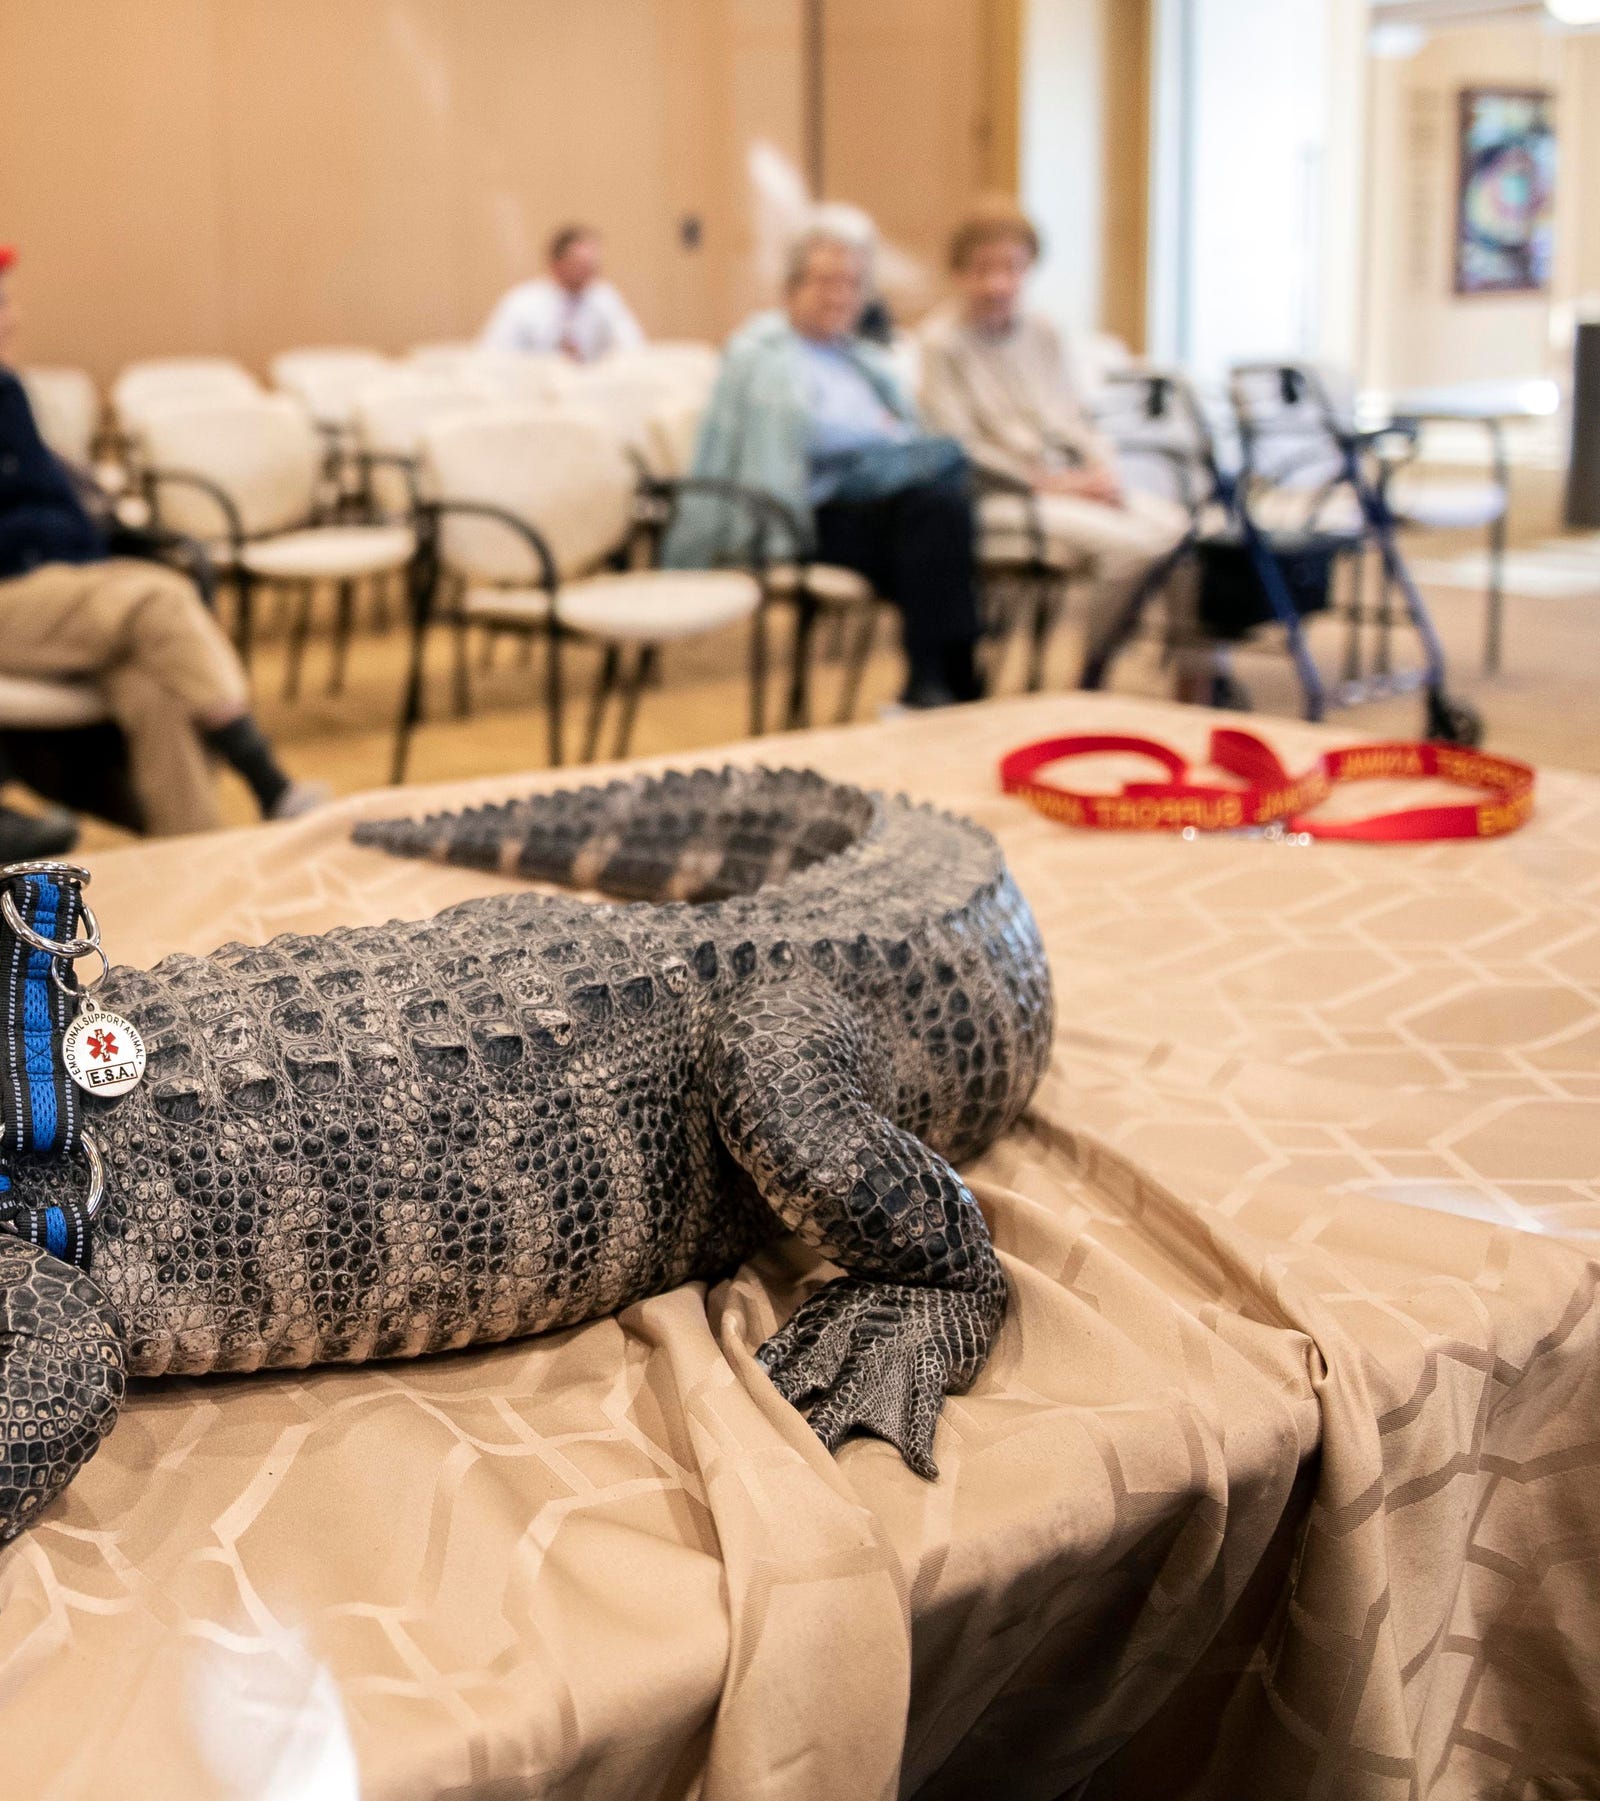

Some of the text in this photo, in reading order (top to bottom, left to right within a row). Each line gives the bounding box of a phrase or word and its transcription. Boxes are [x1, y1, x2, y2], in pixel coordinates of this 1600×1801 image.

[1092, 796, 1242, 829] SUPPORT
[65, 1013, 145, 1076] EMOTIONAL SUPPORT ANIMAL
[90, 1066, 134, 1085] E.S.A.
